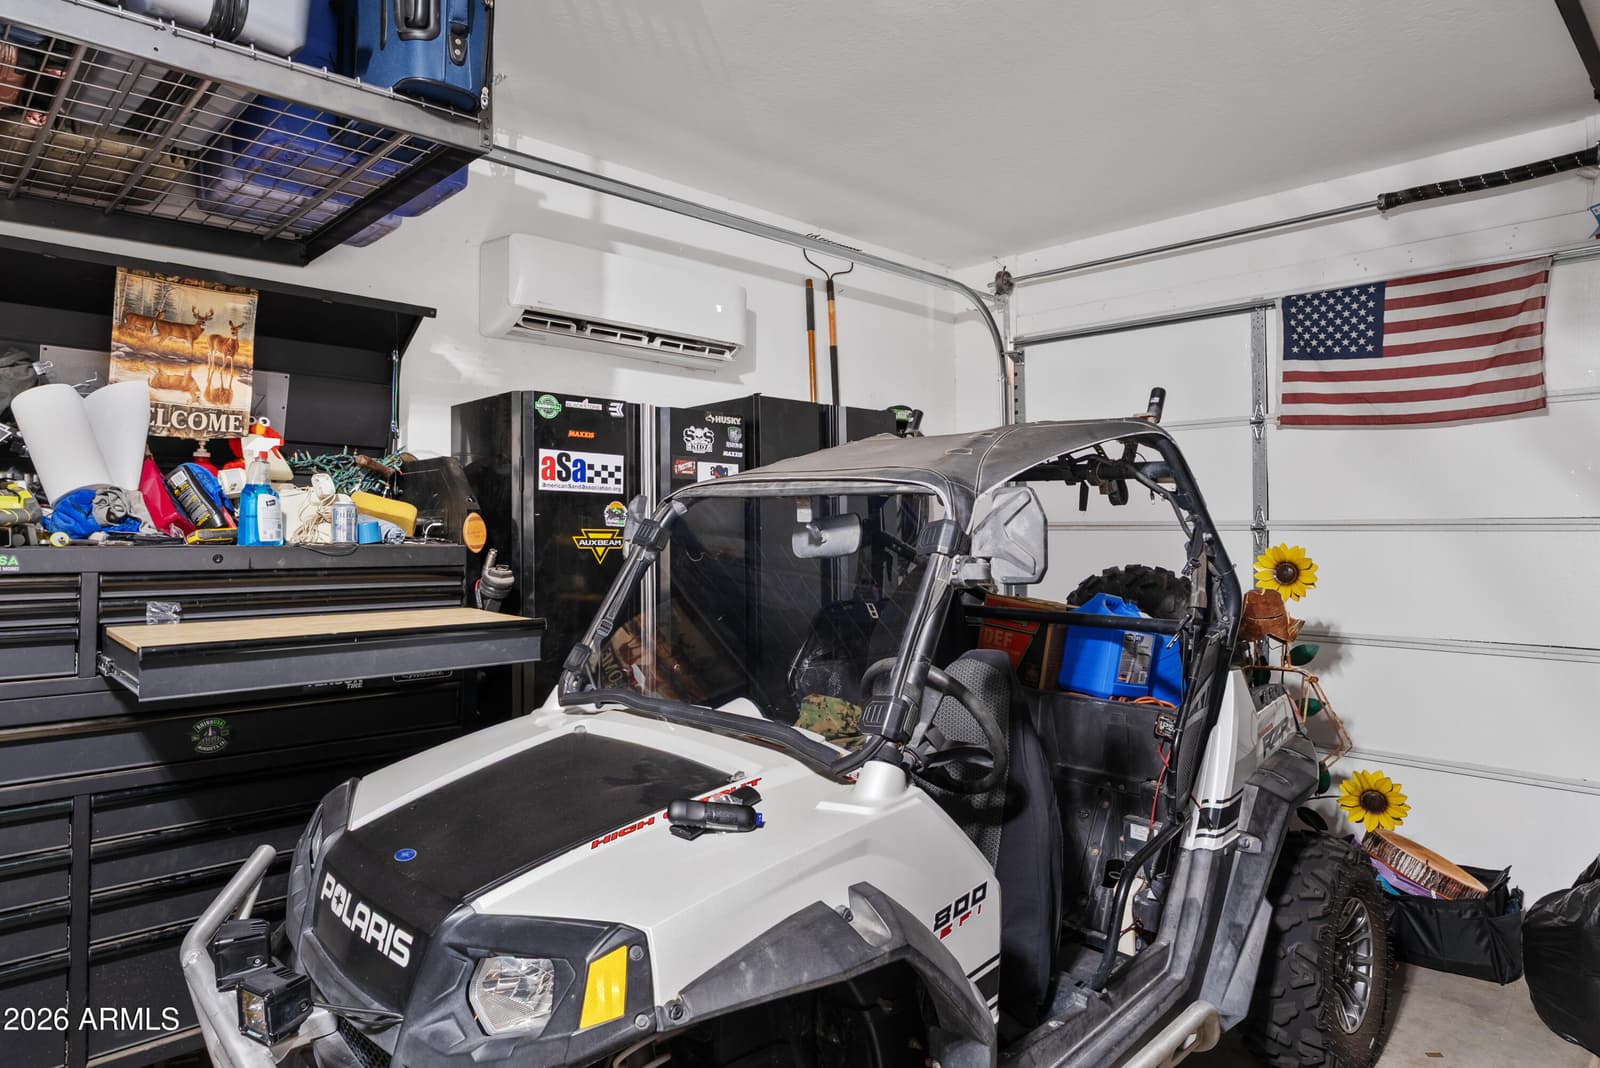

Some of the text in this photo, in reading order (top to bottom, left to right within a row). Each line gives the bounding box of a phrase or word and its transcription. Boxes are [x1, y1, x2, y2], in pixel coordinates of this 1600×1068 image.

[568, 430, 595, 439] MAXXIS
[715, 415, 742, 425] HUSKY
[541, 452, 586, 483] aSa
[591, 816, 655, 849] HIGH
[320, 871, 414, 968] POLARIS
[933, 881, 988, 933] 800
[940, 904, 981, 940] EFI
